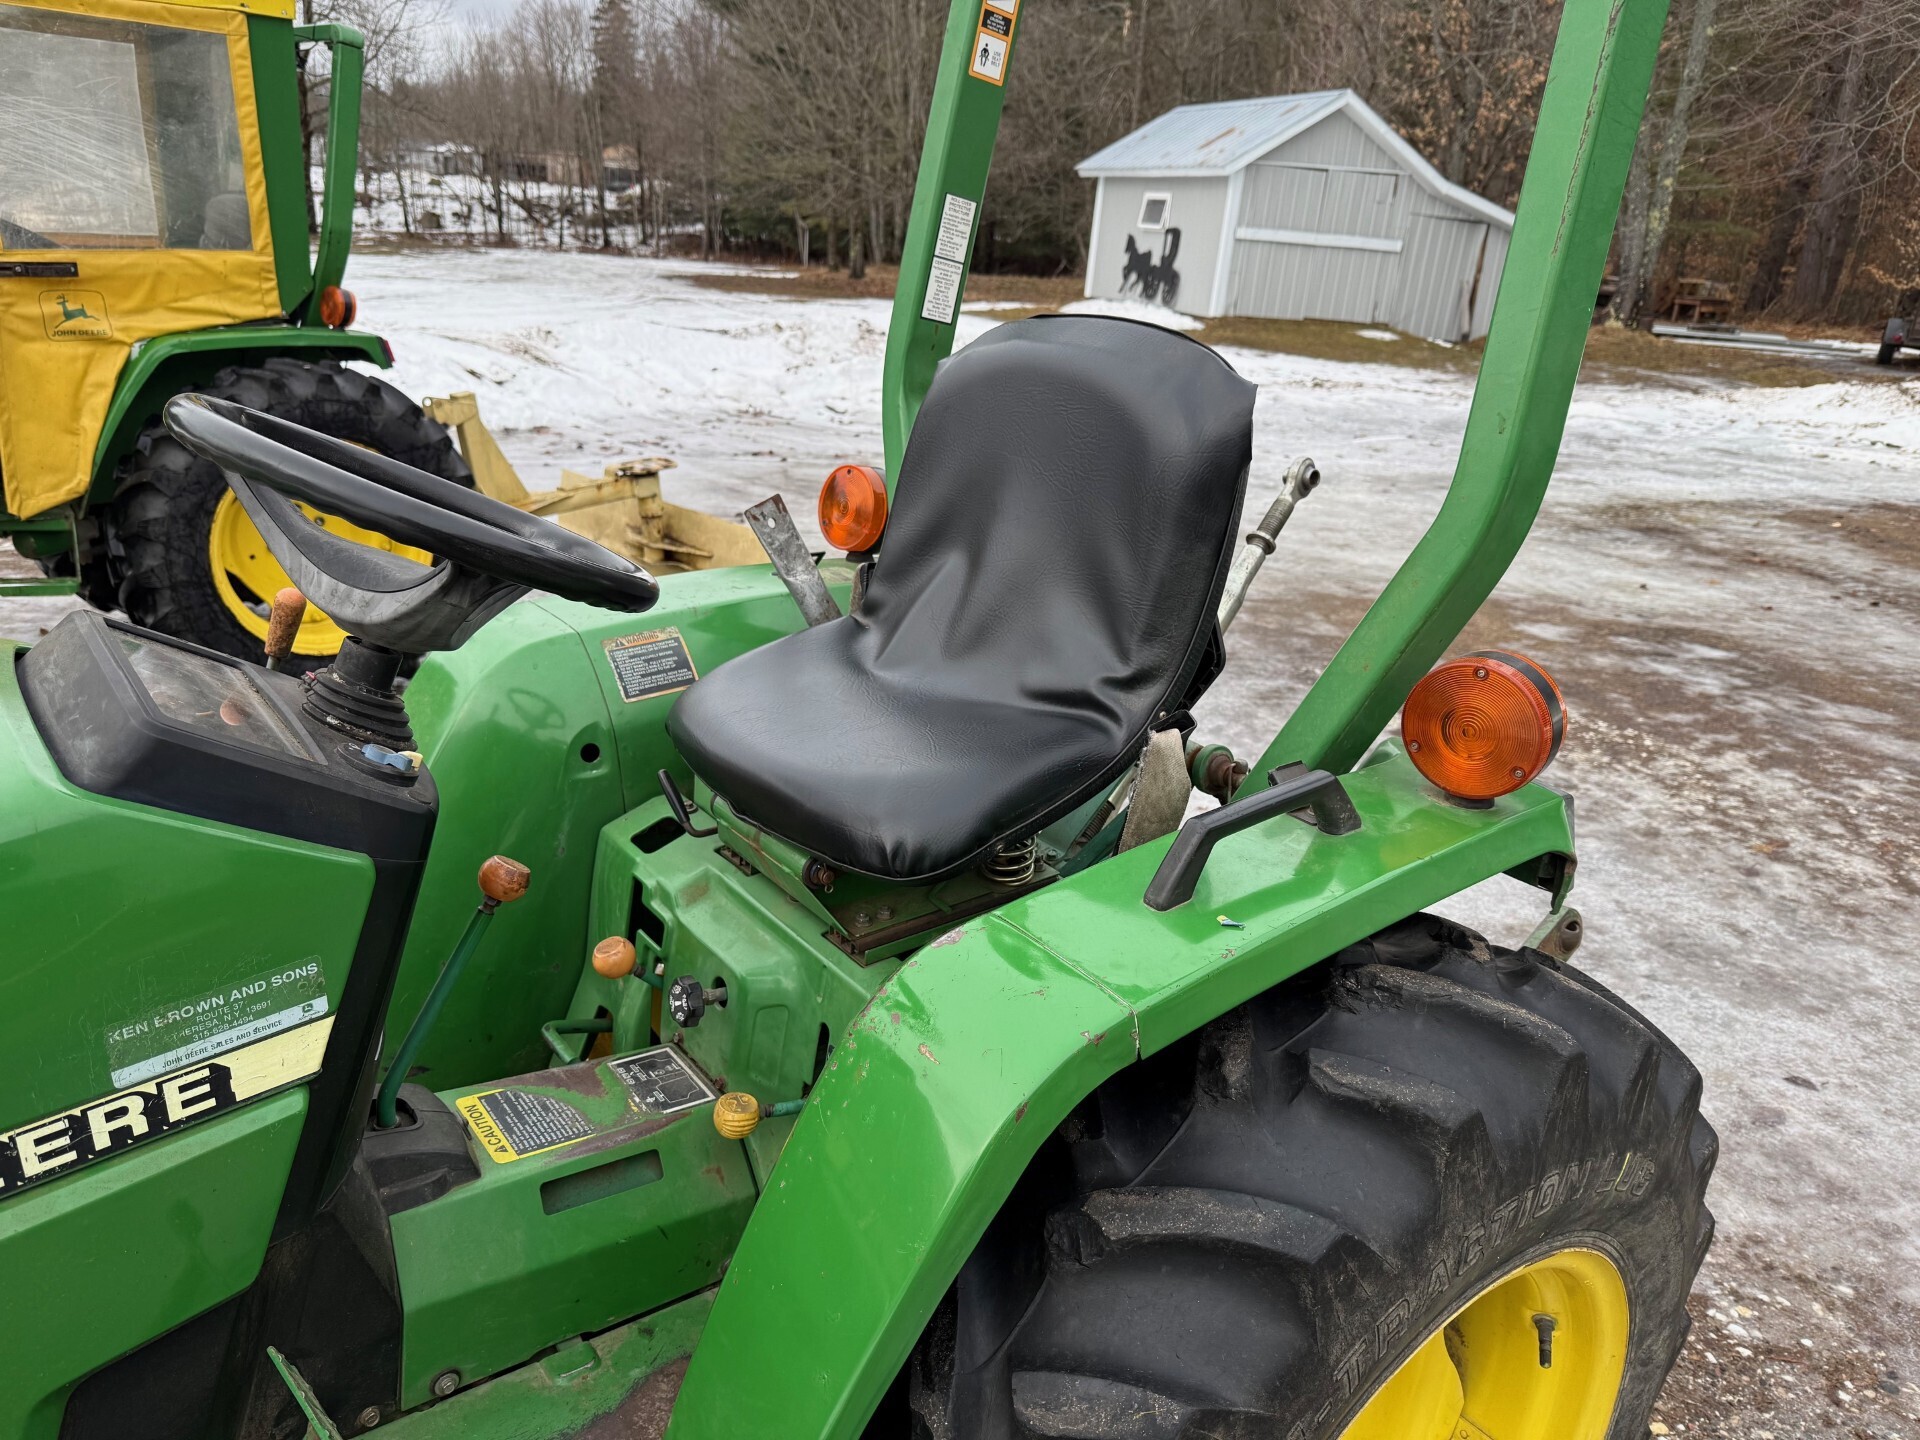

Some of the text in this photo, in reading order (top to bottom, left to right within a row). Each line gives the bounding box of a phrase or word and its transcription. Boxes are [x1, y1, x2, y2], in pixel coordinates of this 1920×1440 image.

[626, 631, 659, 644] WARNING
[109, 963, 318, 1043] KEN BROWN AND SONS
[196, 1006, 230, 1022] ROUTE
[247, 999, 271, 1013] 13691
[163, 1019, 282, 1068] JOHN DEERE SALES AND SERVICE
[193, 1014, 254, 1041] 315-628-4494
[0, 1067, 216, 1188] ERE
[466, 1104, 502, 1146] CAUTION
[1596, 1152, 1655, 1197] LUG
